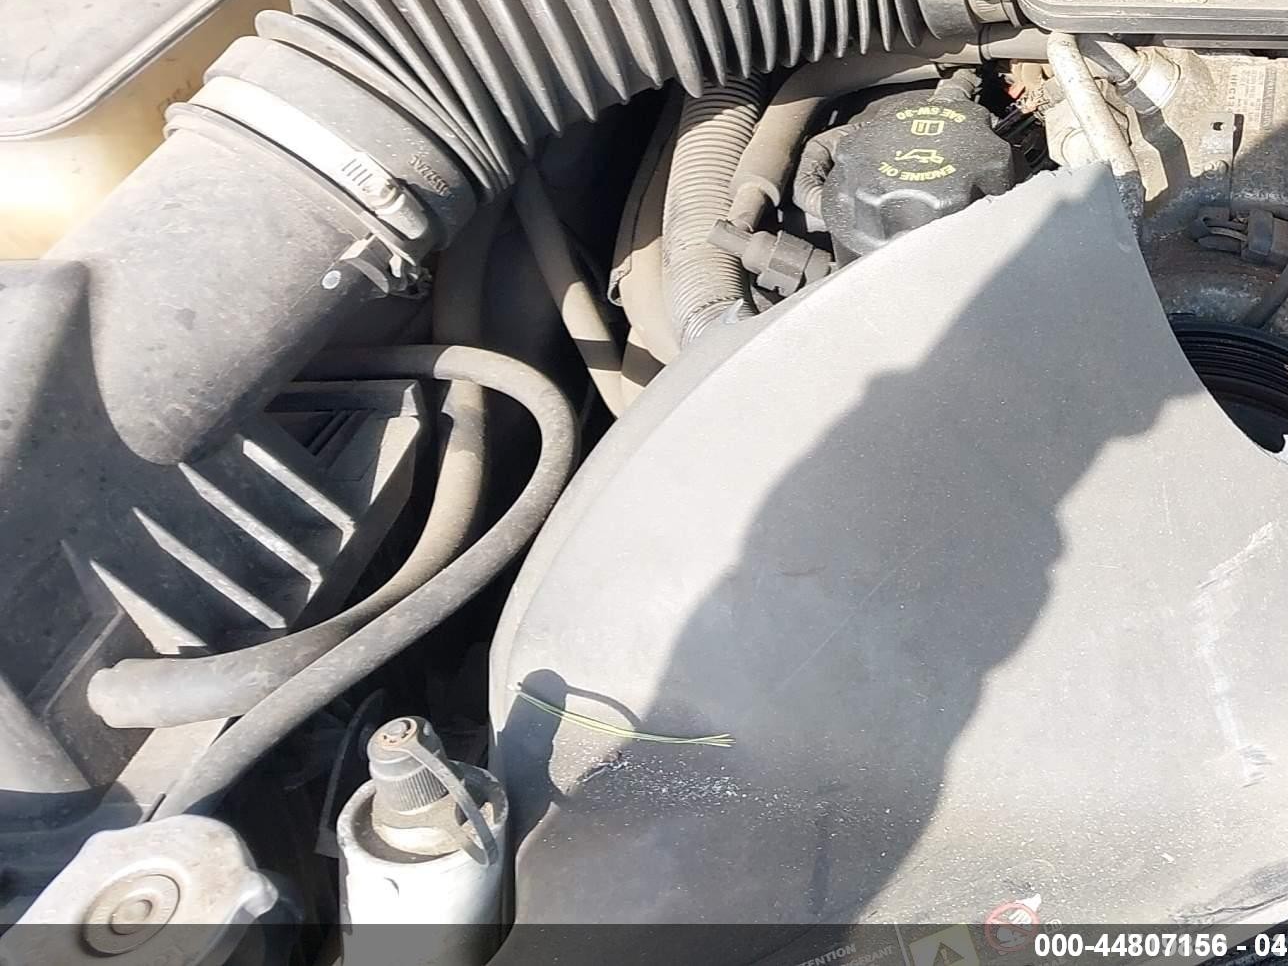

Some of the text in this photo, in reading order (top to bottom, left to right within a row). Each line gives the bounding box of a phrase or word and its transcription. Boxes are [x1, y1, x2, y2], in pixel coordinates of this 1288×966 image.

[895, 105, 967, 124] SAE 5W-30
[878, 161, 957, 182] ENGINE OIL
